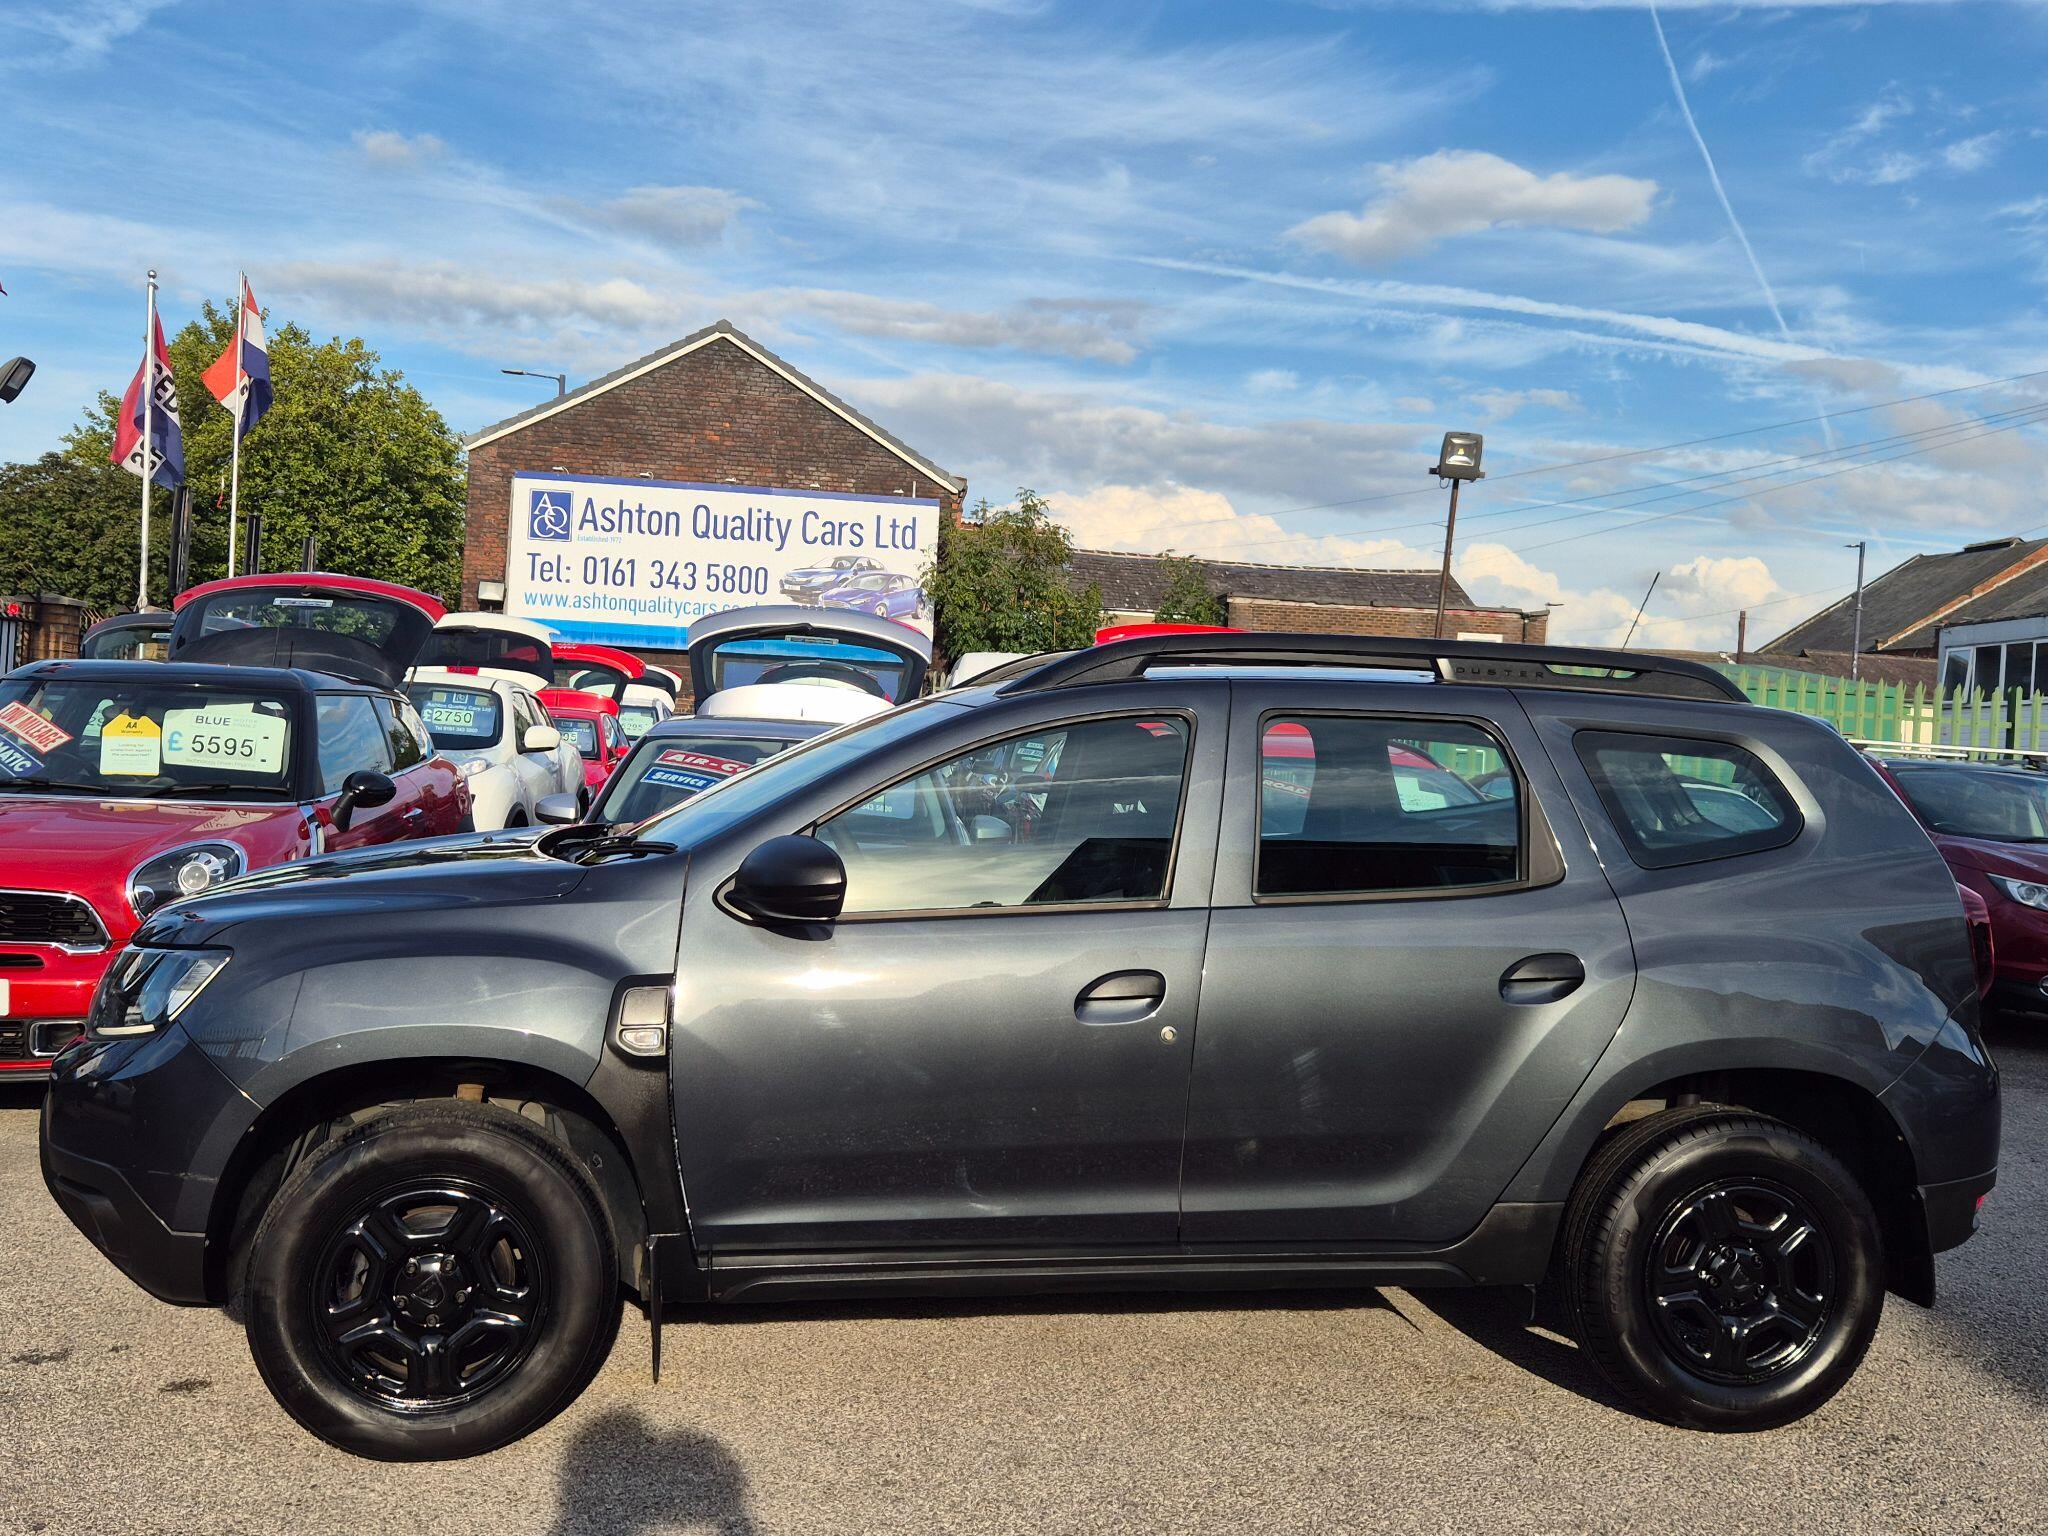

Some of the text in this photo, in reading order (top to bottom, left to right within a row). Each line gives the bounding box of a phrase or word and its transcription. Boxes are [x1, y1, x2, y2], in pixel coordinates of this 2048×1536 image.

[578, 497, 917, 552] Ashton Quality Cars Ltd
[526, 552, 769, 595] Tel: 0161 343 5800
[1455, 667, 1544, 679] DUSTER
[195, 715, 231, 726] BLUE
[15, 715, 64, 748] MILEAGE
[665, 753, 747, 773] AIR-C
[652, 771, 708, 786] SERVICE
